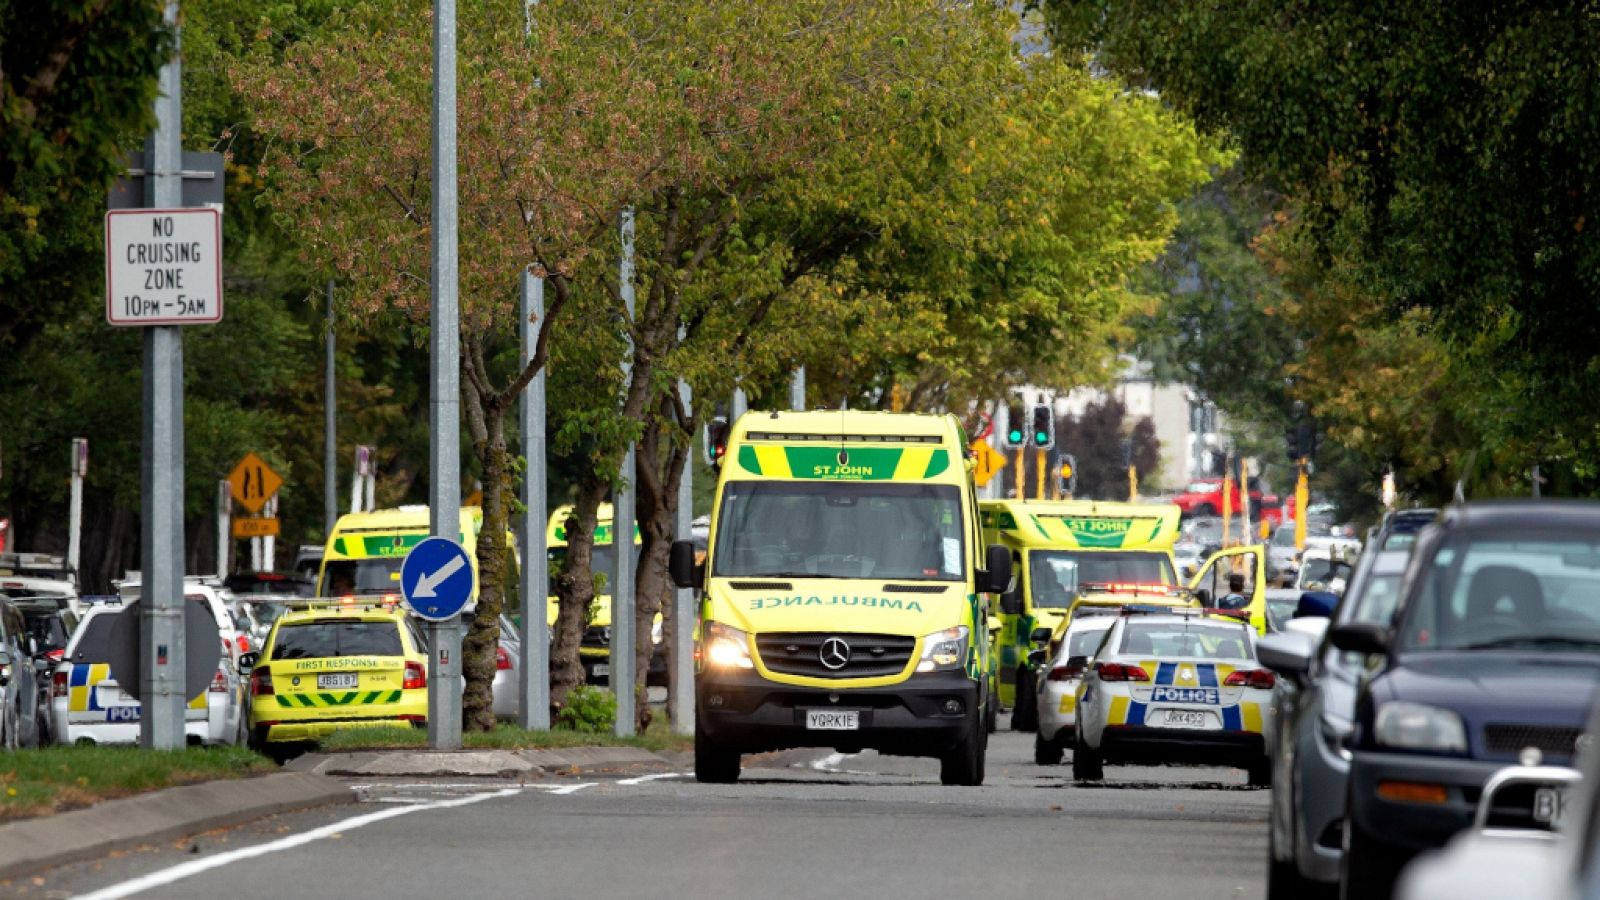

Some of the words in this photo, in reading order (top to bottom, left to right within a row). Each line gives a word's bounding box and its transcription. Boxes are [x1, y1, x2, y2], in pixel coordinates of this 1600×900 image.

[152, 216, 173, 237] NO
[127, 242, 201, 264] CRUISING
[144, 269, 184, 290] ZONE
[124, 296, 160, 317] 10PM
[177, 294, 206, 315] 5AM
[814, 465, 831, 475] ST
[833, 465, 873, 476] JOHN
[1069, 520, 1086, 531] ST
[1089, 521, 1127, 532] JOHN
[296, 661, 323, 670] FIRST
[326, 659, 379, 669] RESPONSE
[1154, 688, 1218, 704] POLICE
[110, 706, 142, 721] POL
